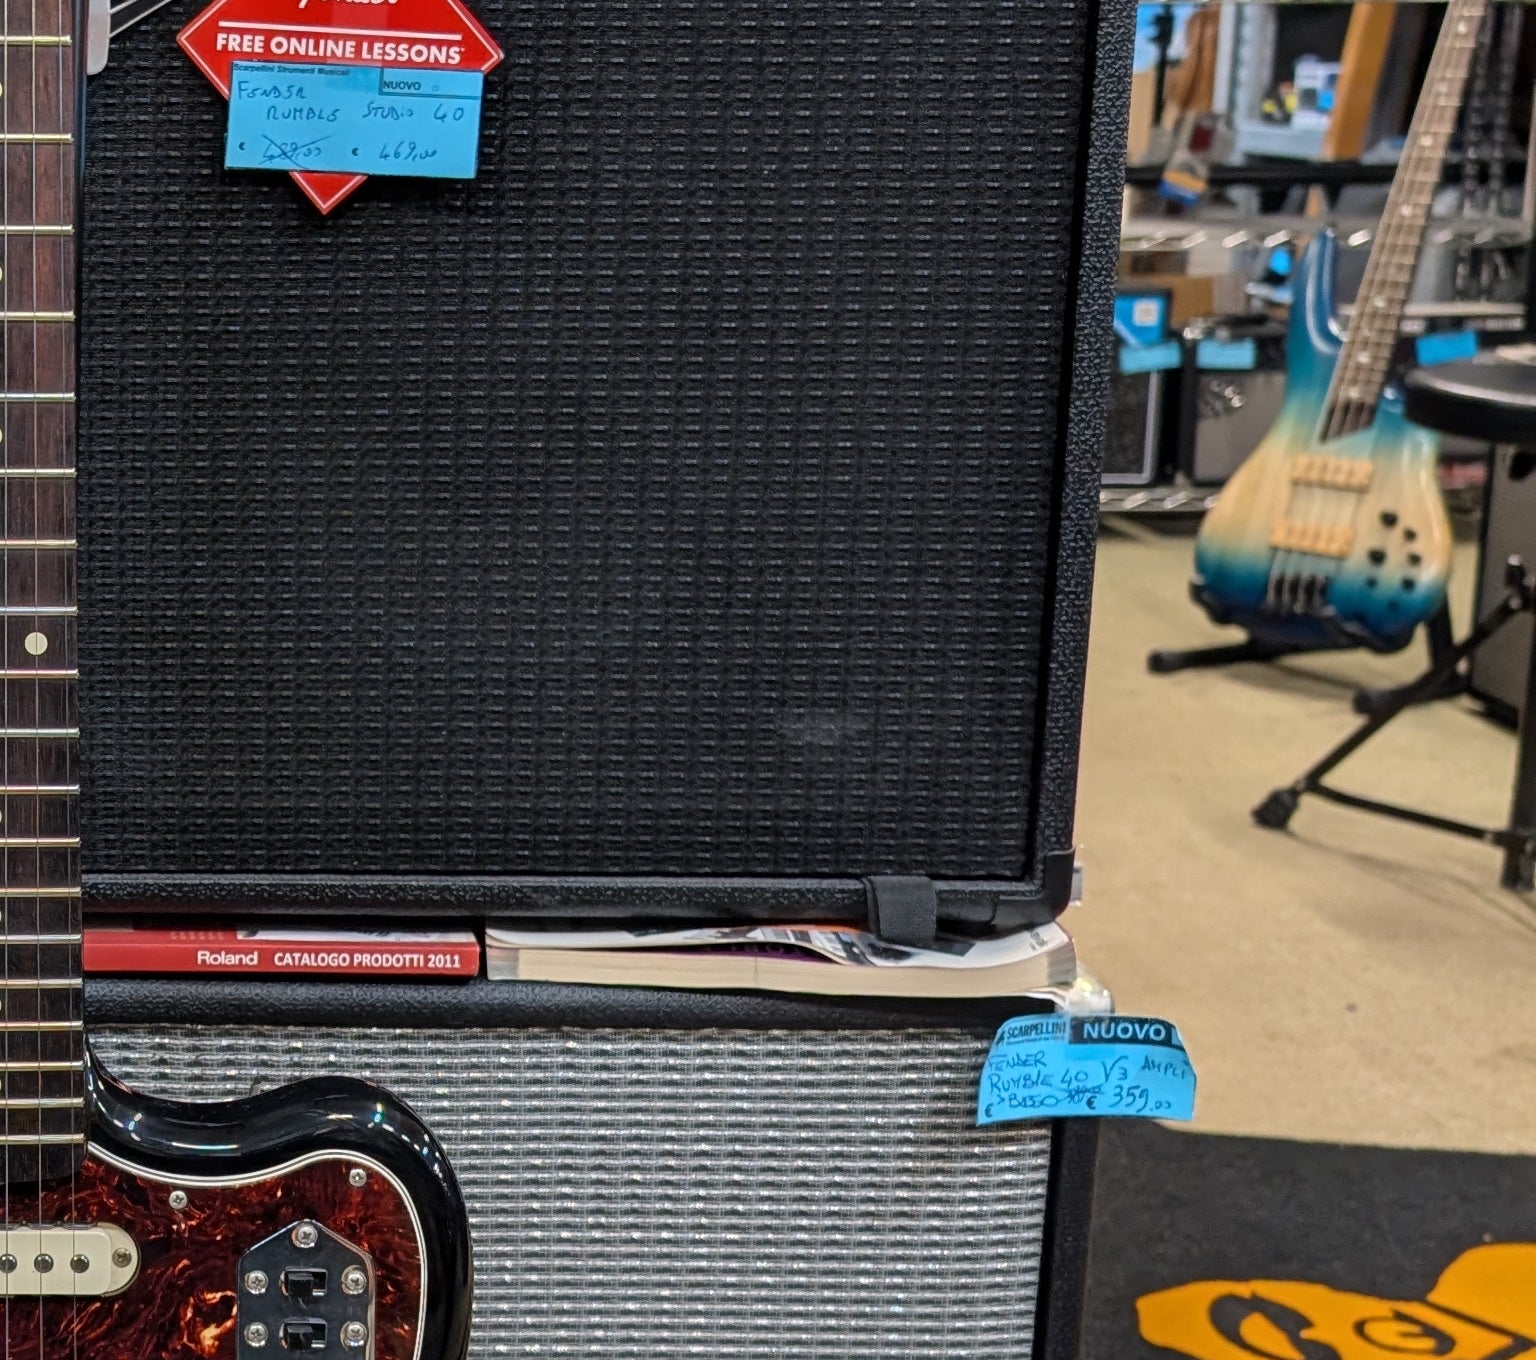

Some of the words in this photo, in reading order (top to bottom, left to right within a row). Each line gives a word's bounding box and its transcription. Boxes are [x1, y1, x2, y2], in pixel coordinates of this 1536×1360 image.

[216, 33, 265, 53] FREE
[270, 37, 355, 58] ONLINE
[361, 41, 462, 65] LESSONS
[383, 80, 421, 91] NUOVO
[197, 950, 258, 965] Roland
[274, 951, 351, 968] CATALOGO
[353, 953, 424, 969] PRODOTTI
[427, 953, 461, 969] 2011
[1007, 1021, 1067, 1040] SCARPELLINI
[1083, 1021, 1166, 1040] NUOVO
[1061, 1068, 1089, 1088] 40
